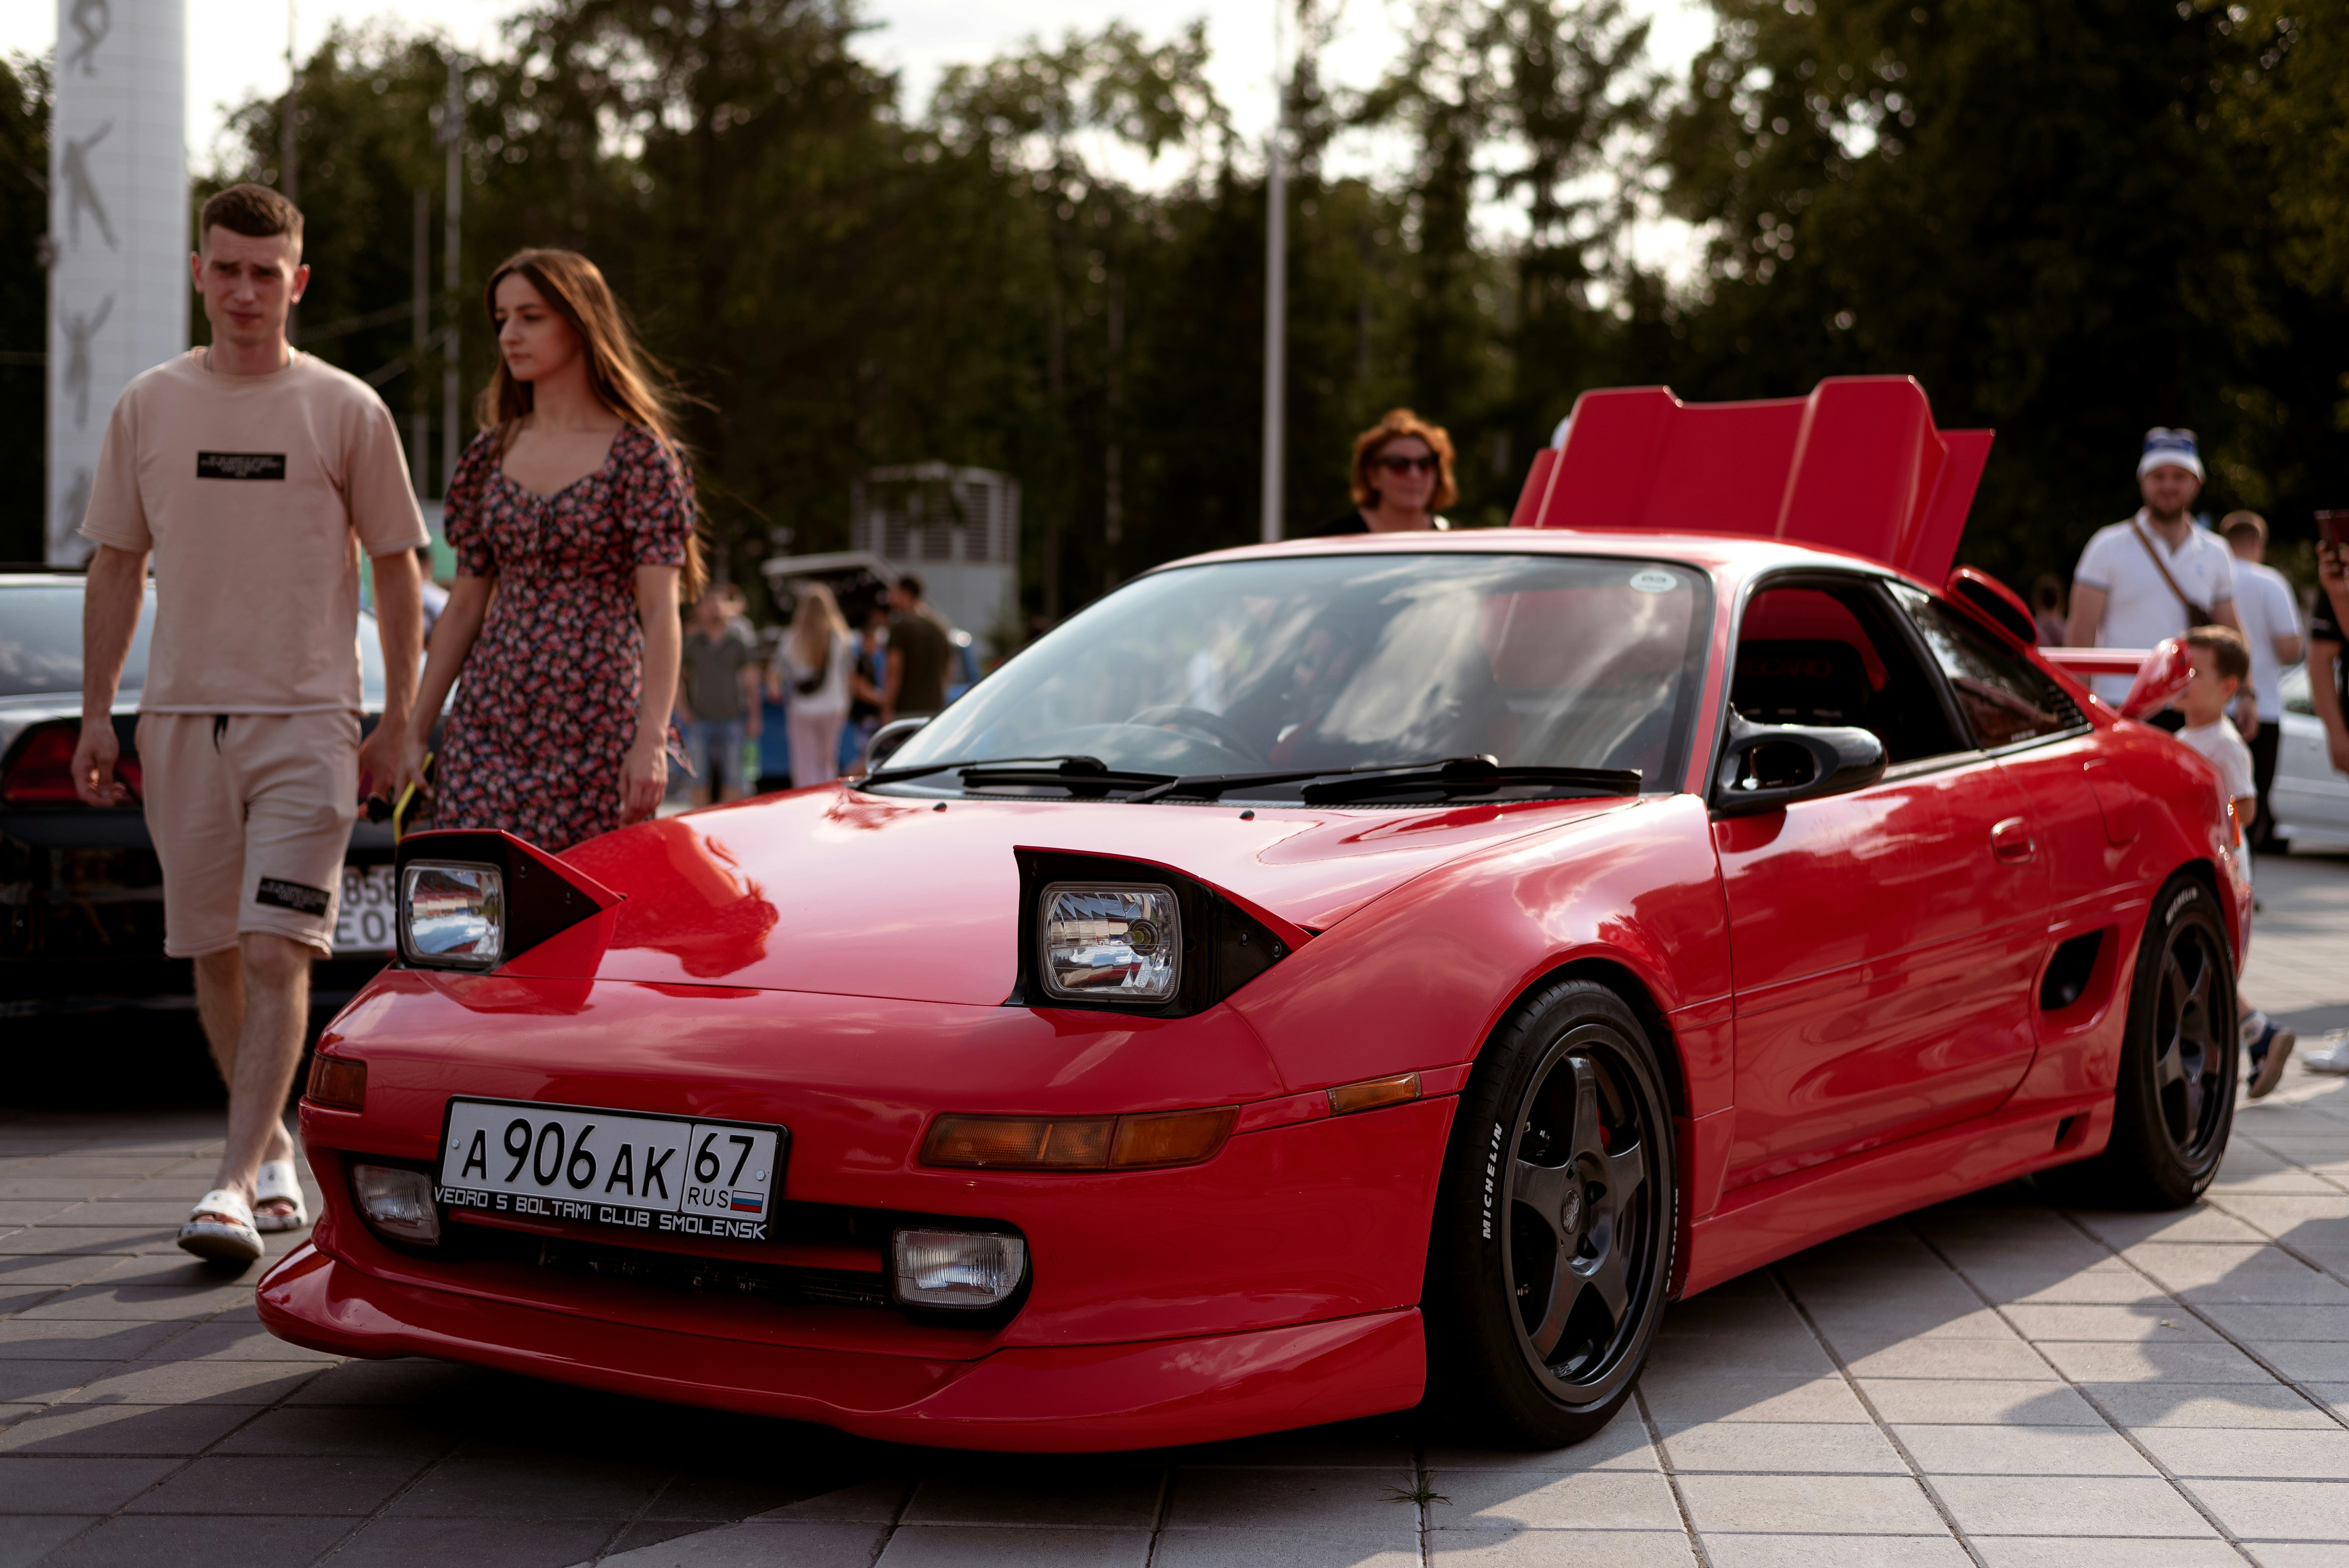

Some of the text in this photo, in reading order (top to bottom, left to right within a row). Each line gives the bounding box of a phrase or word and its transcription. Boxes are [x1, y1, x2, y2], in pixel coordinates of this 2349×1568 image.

[694, 1132, 755, 1188] 67
[1483, 1122, 1502, 1239] MICHELIN
[434, 1186, 767, 1240] VEDRO S BOLTAMI CLUB SMOLENSK
[687, 1186, 729, 1209] RUS
